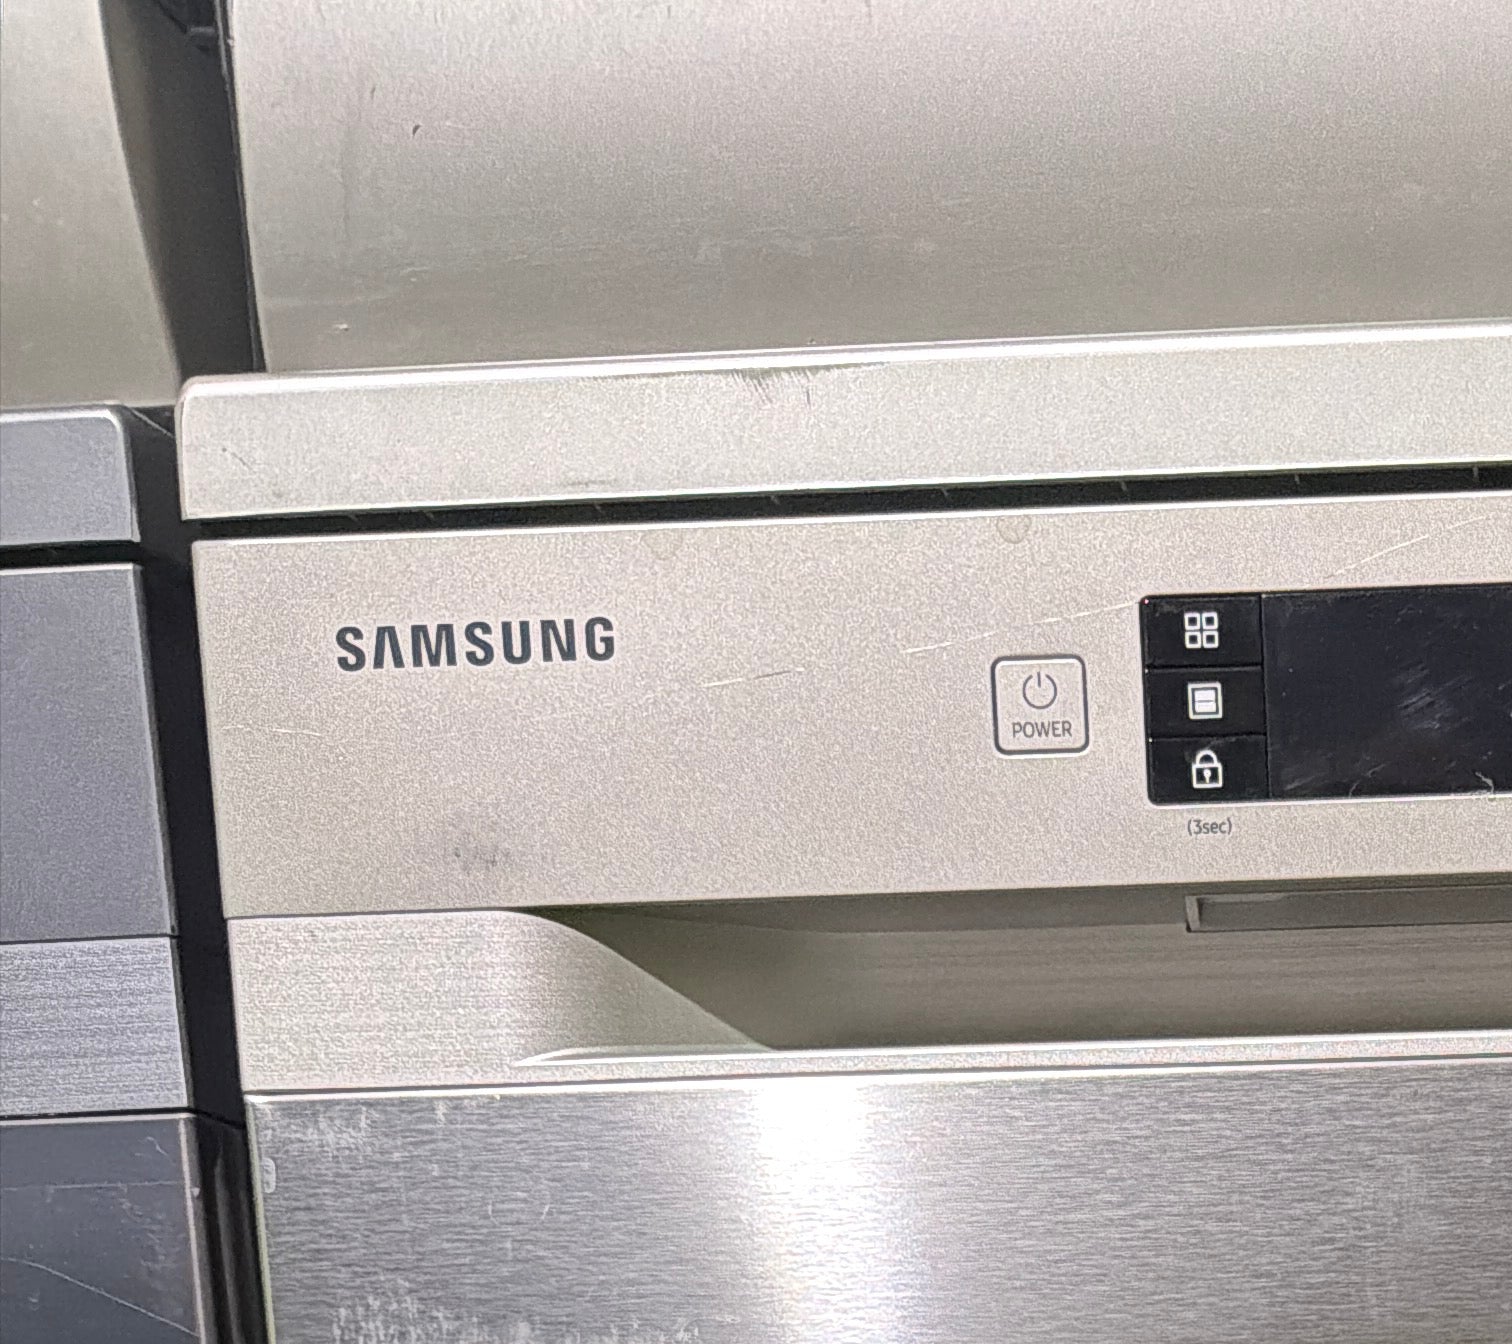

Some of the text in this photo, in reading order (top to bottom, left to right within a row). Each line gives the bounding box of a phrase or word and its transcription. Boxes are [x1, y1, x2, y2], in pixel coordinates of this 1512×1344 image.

[335, 617, 616, 672] SAMSUNG
[1011, 720, 1073, 738] POWER
[1187, 818, 1233, 836] (3sec)
